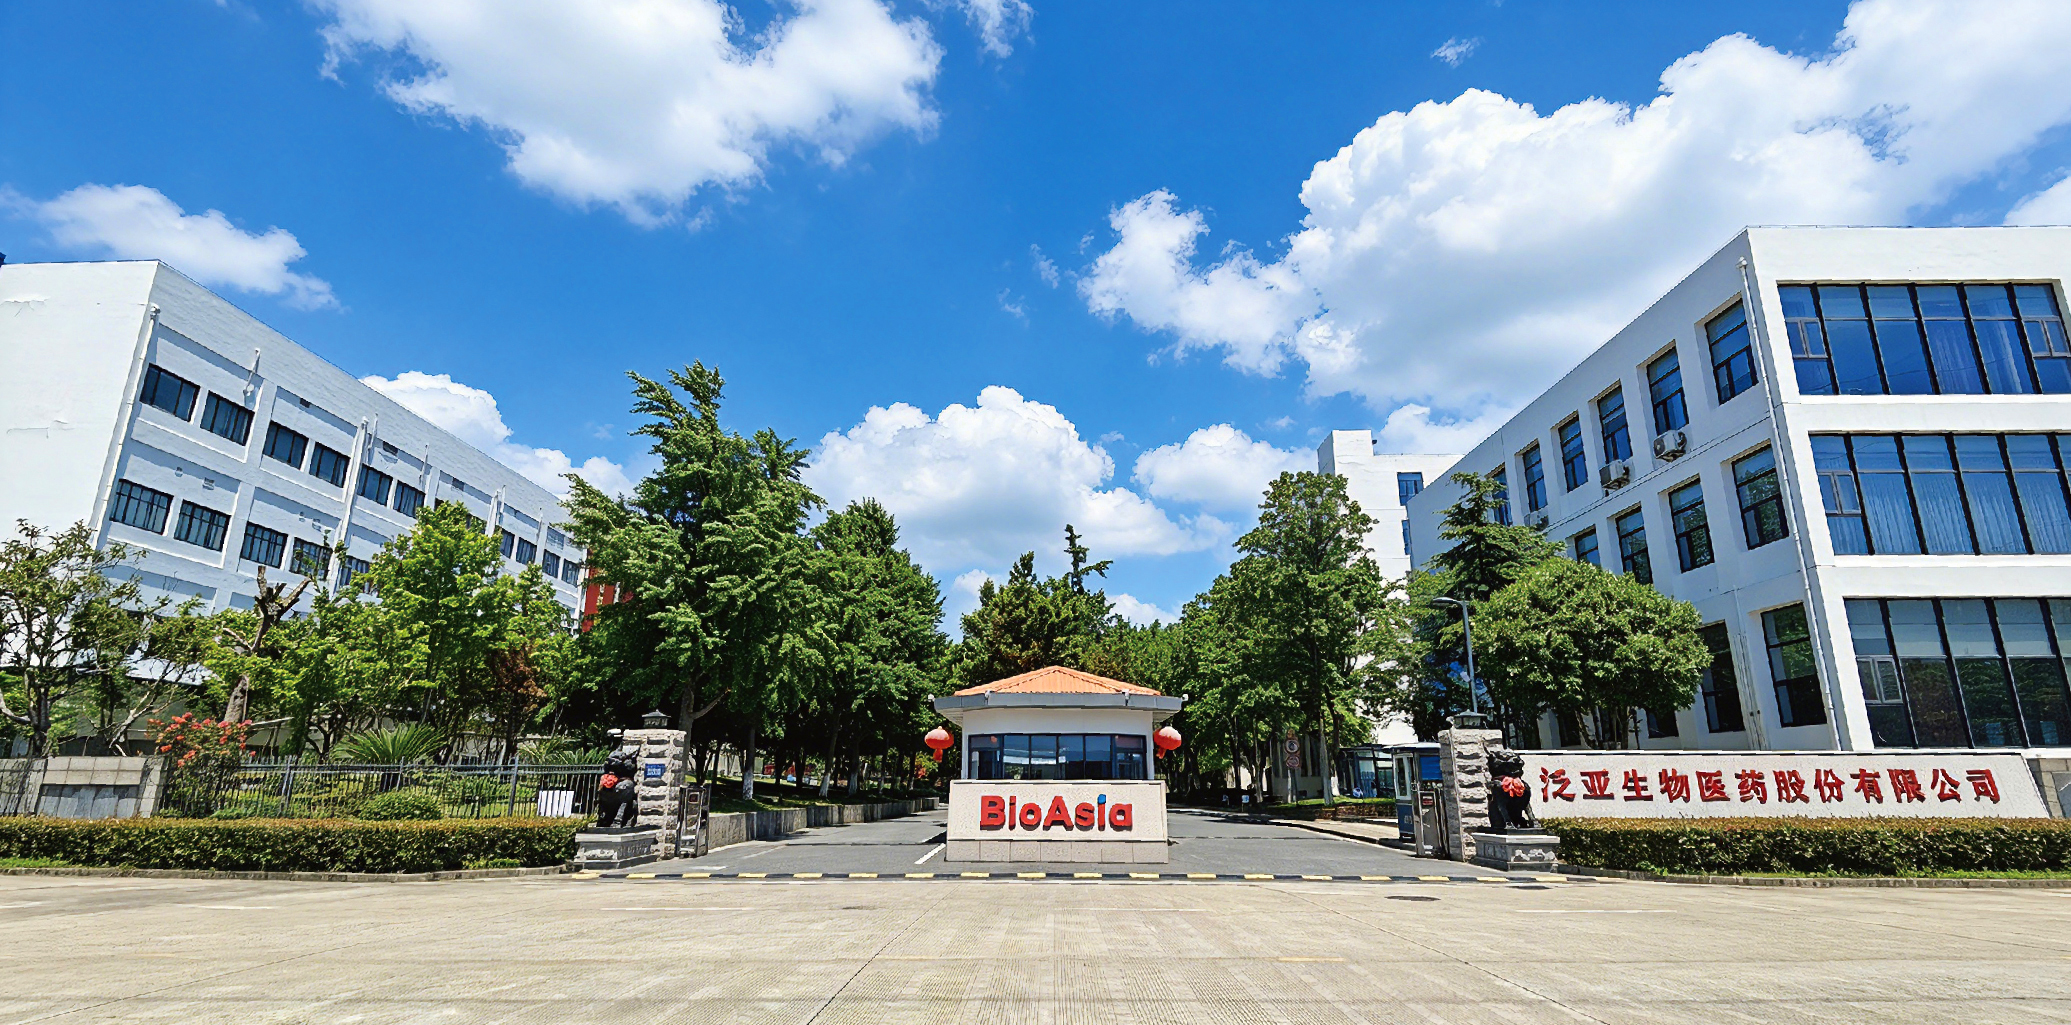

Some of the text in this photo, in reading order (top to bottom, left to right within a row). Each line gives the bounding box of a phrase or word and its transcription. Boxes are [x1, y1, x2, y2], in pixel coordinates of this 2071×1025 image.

[1539, 767, 2000, 804] 泛亚生物医药股份有限公司
[980, 794, 1133, 830] BioAsia
